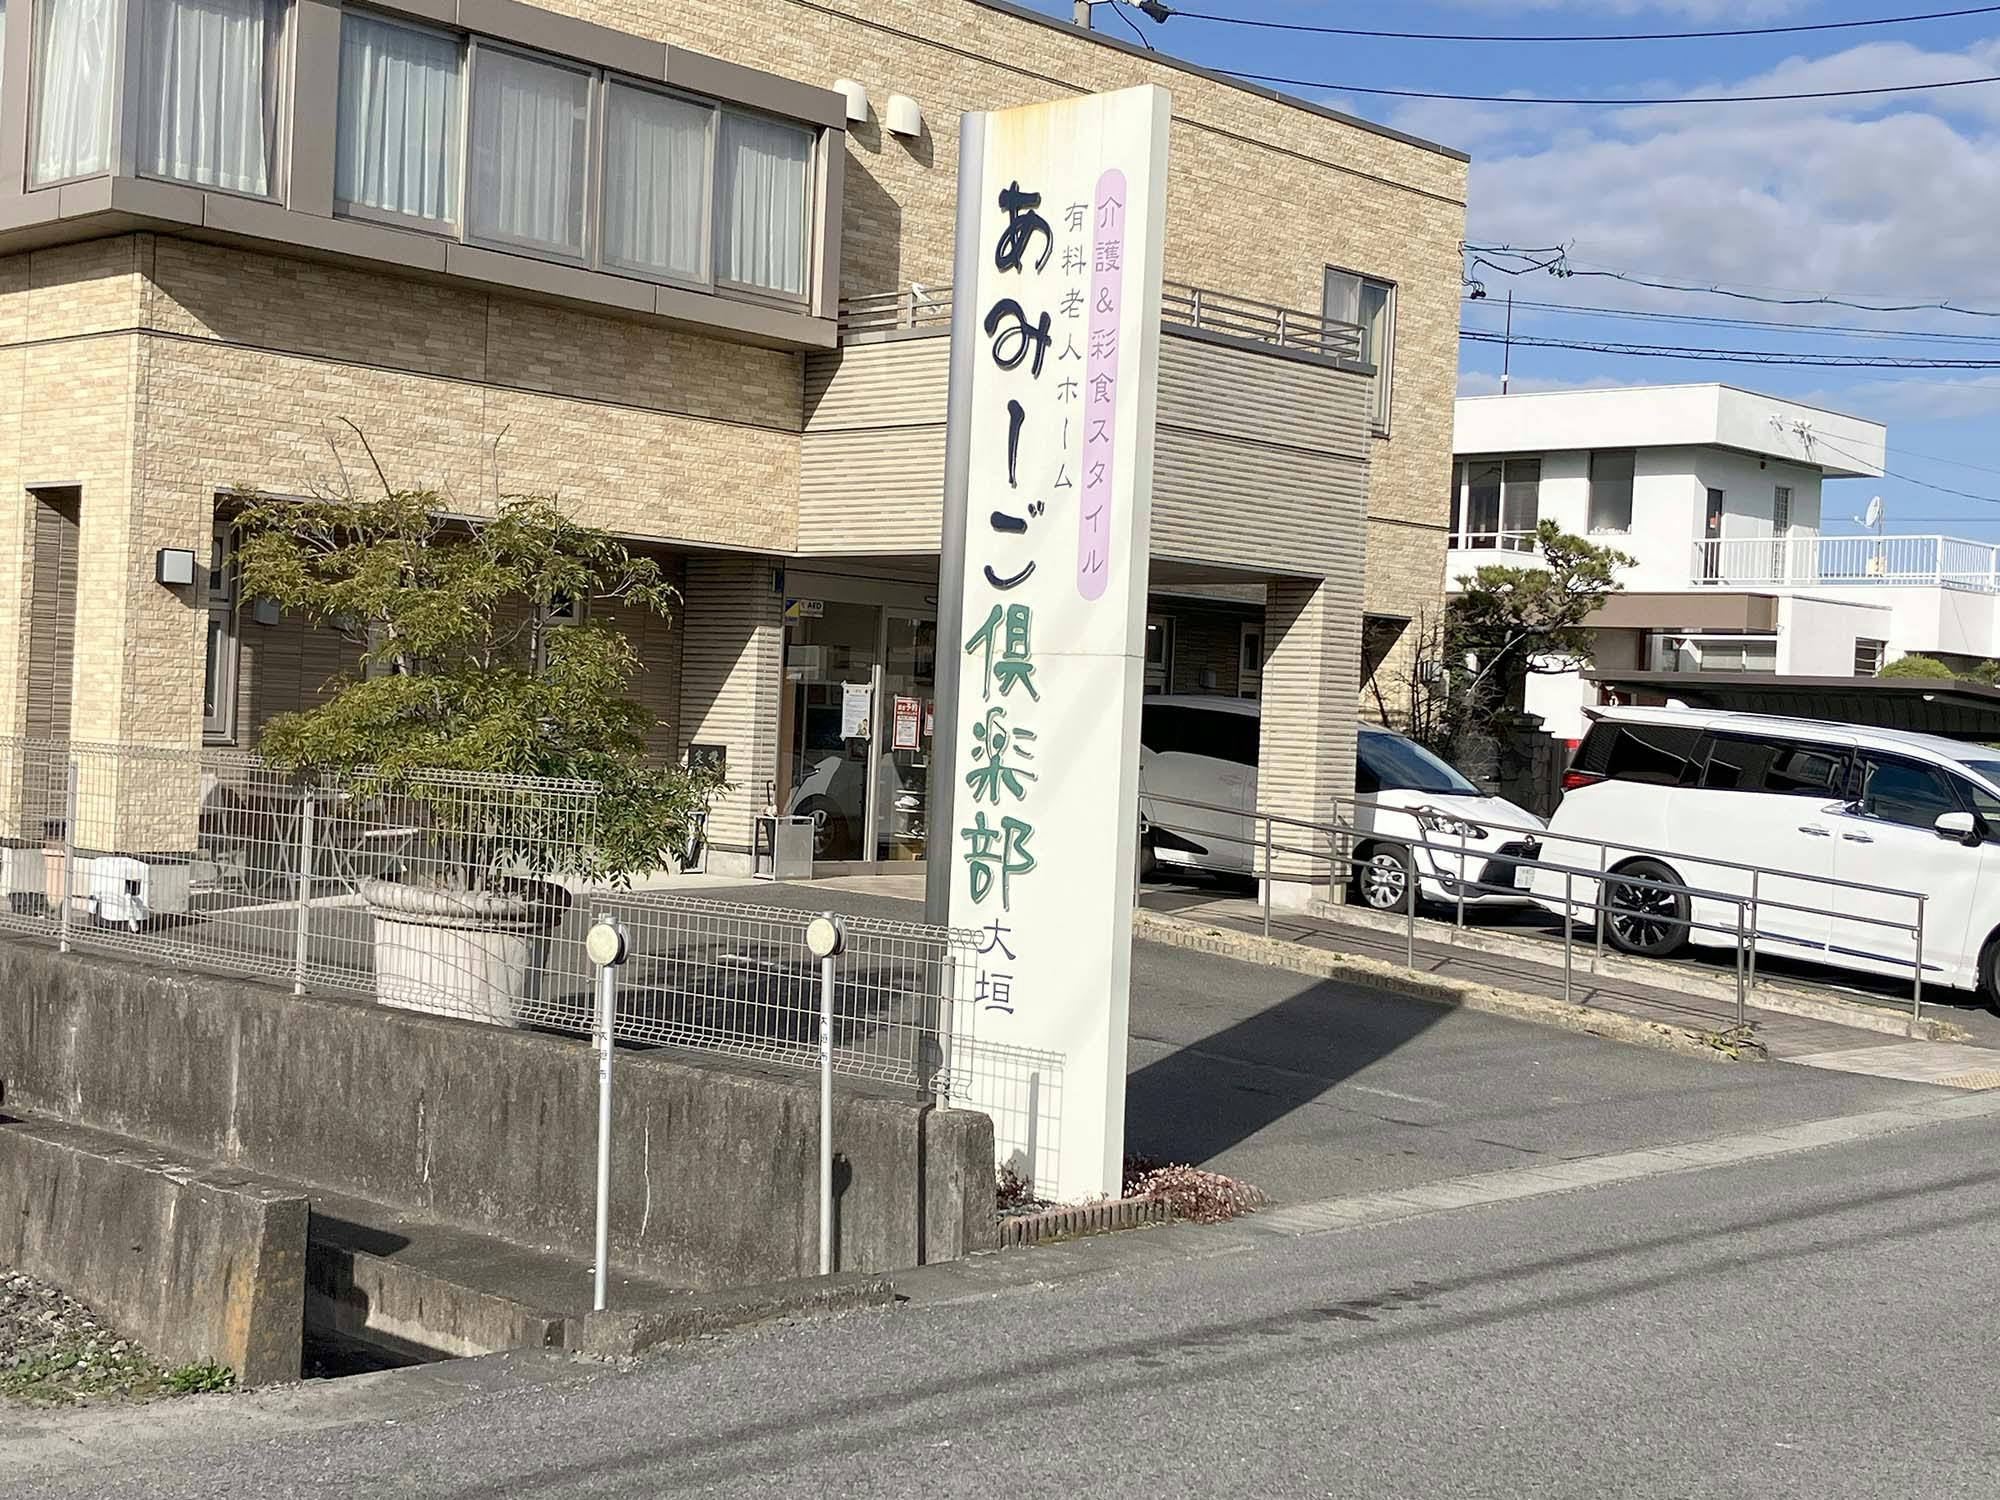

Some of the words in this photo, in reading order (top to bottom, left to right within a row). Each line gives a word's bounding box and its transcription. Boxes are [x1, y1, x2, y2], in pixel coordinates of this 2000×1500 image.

[1053, 201, 1089, 489] 有料老人ホーム
[1081, 195, 1123, 574] 介護&彩食スタイル
[975, 917, 1017, 1014] 大垣
